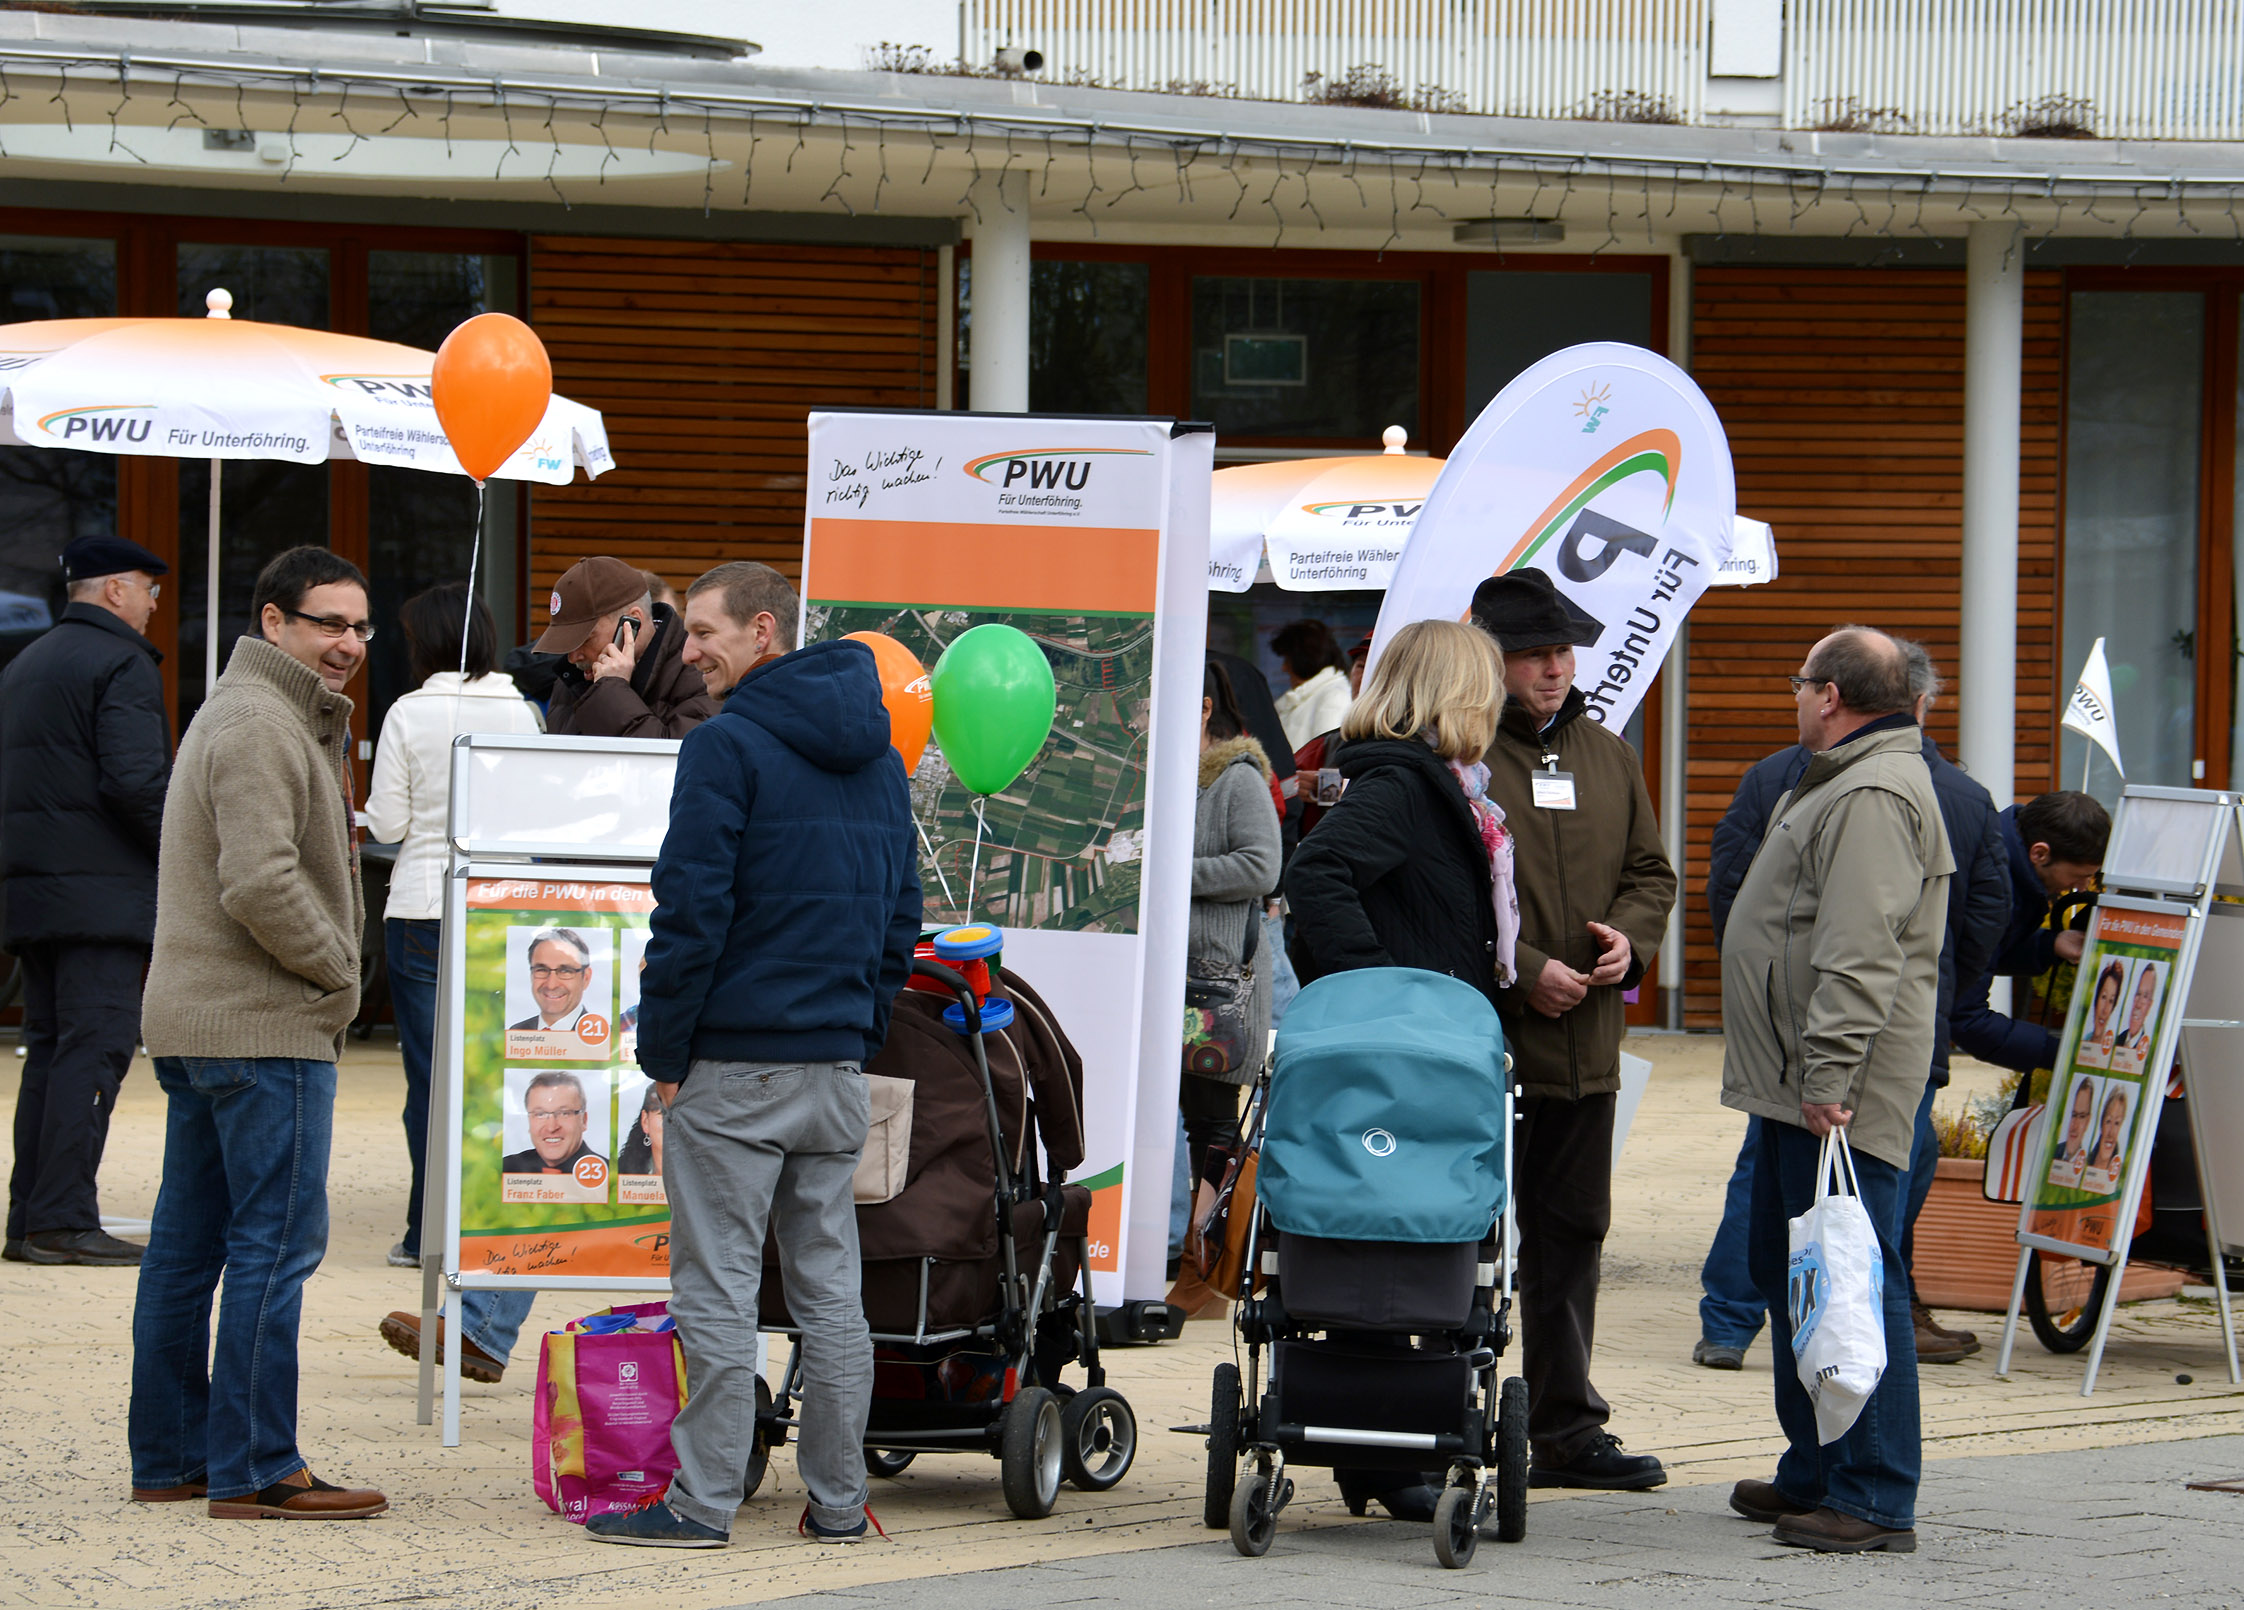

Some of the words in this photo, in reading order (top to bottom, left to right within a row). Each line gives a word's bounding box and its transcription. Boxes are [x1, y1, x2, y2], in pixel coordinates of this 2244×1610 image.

[352, 379, 433, 399] PW
[63, 417, 152, 442] PWU
[168, 429, 199, 445] Für
[201, 431, 311, 453] Unterföhring.
[355, 424, 404, 441] Parteifreie
[406, 429, 451, 446] Wählersc
[359, 439, 416, 460] Unterföhring
[537, 457, 563, 471] FW
[1002, 459, 1092, 491] PWU
[998, 493, 1016, 506] Für
[1018, 494, 1083, 510] Unterföhring.
[1290, 550, 1353, 564] Parteifreie
[1357, 549, 1400, 562] Wähler
[1290, 565, 1368, 580] Unterföhring
[478, 883, 507, 898] Für
[512, 884, 539, 899] die
[542, 884, 586, 900] PWU
[590, 886, 606, 900] in
[610, 886, 643, 901] den
[581, 1020, 605, 1037] 21
[510, 1034, 545, 1043] Listenplatz
[510, 1046, 532, 1056] Ingo
[534, 1046, 568, 1056] Müller
[578, 1162, 604, 1180] 23
[507, 1178, 542, 1186] Listenplatz
[622, 1179, 657, 1187] Listenplatz
[507, 1189, 534, 1199] Franz
[536, 1189, 565, 1199] Faber
[622, 1190, 665, 1200] Manuela
[1088, 1240, 1110, 1258] de
